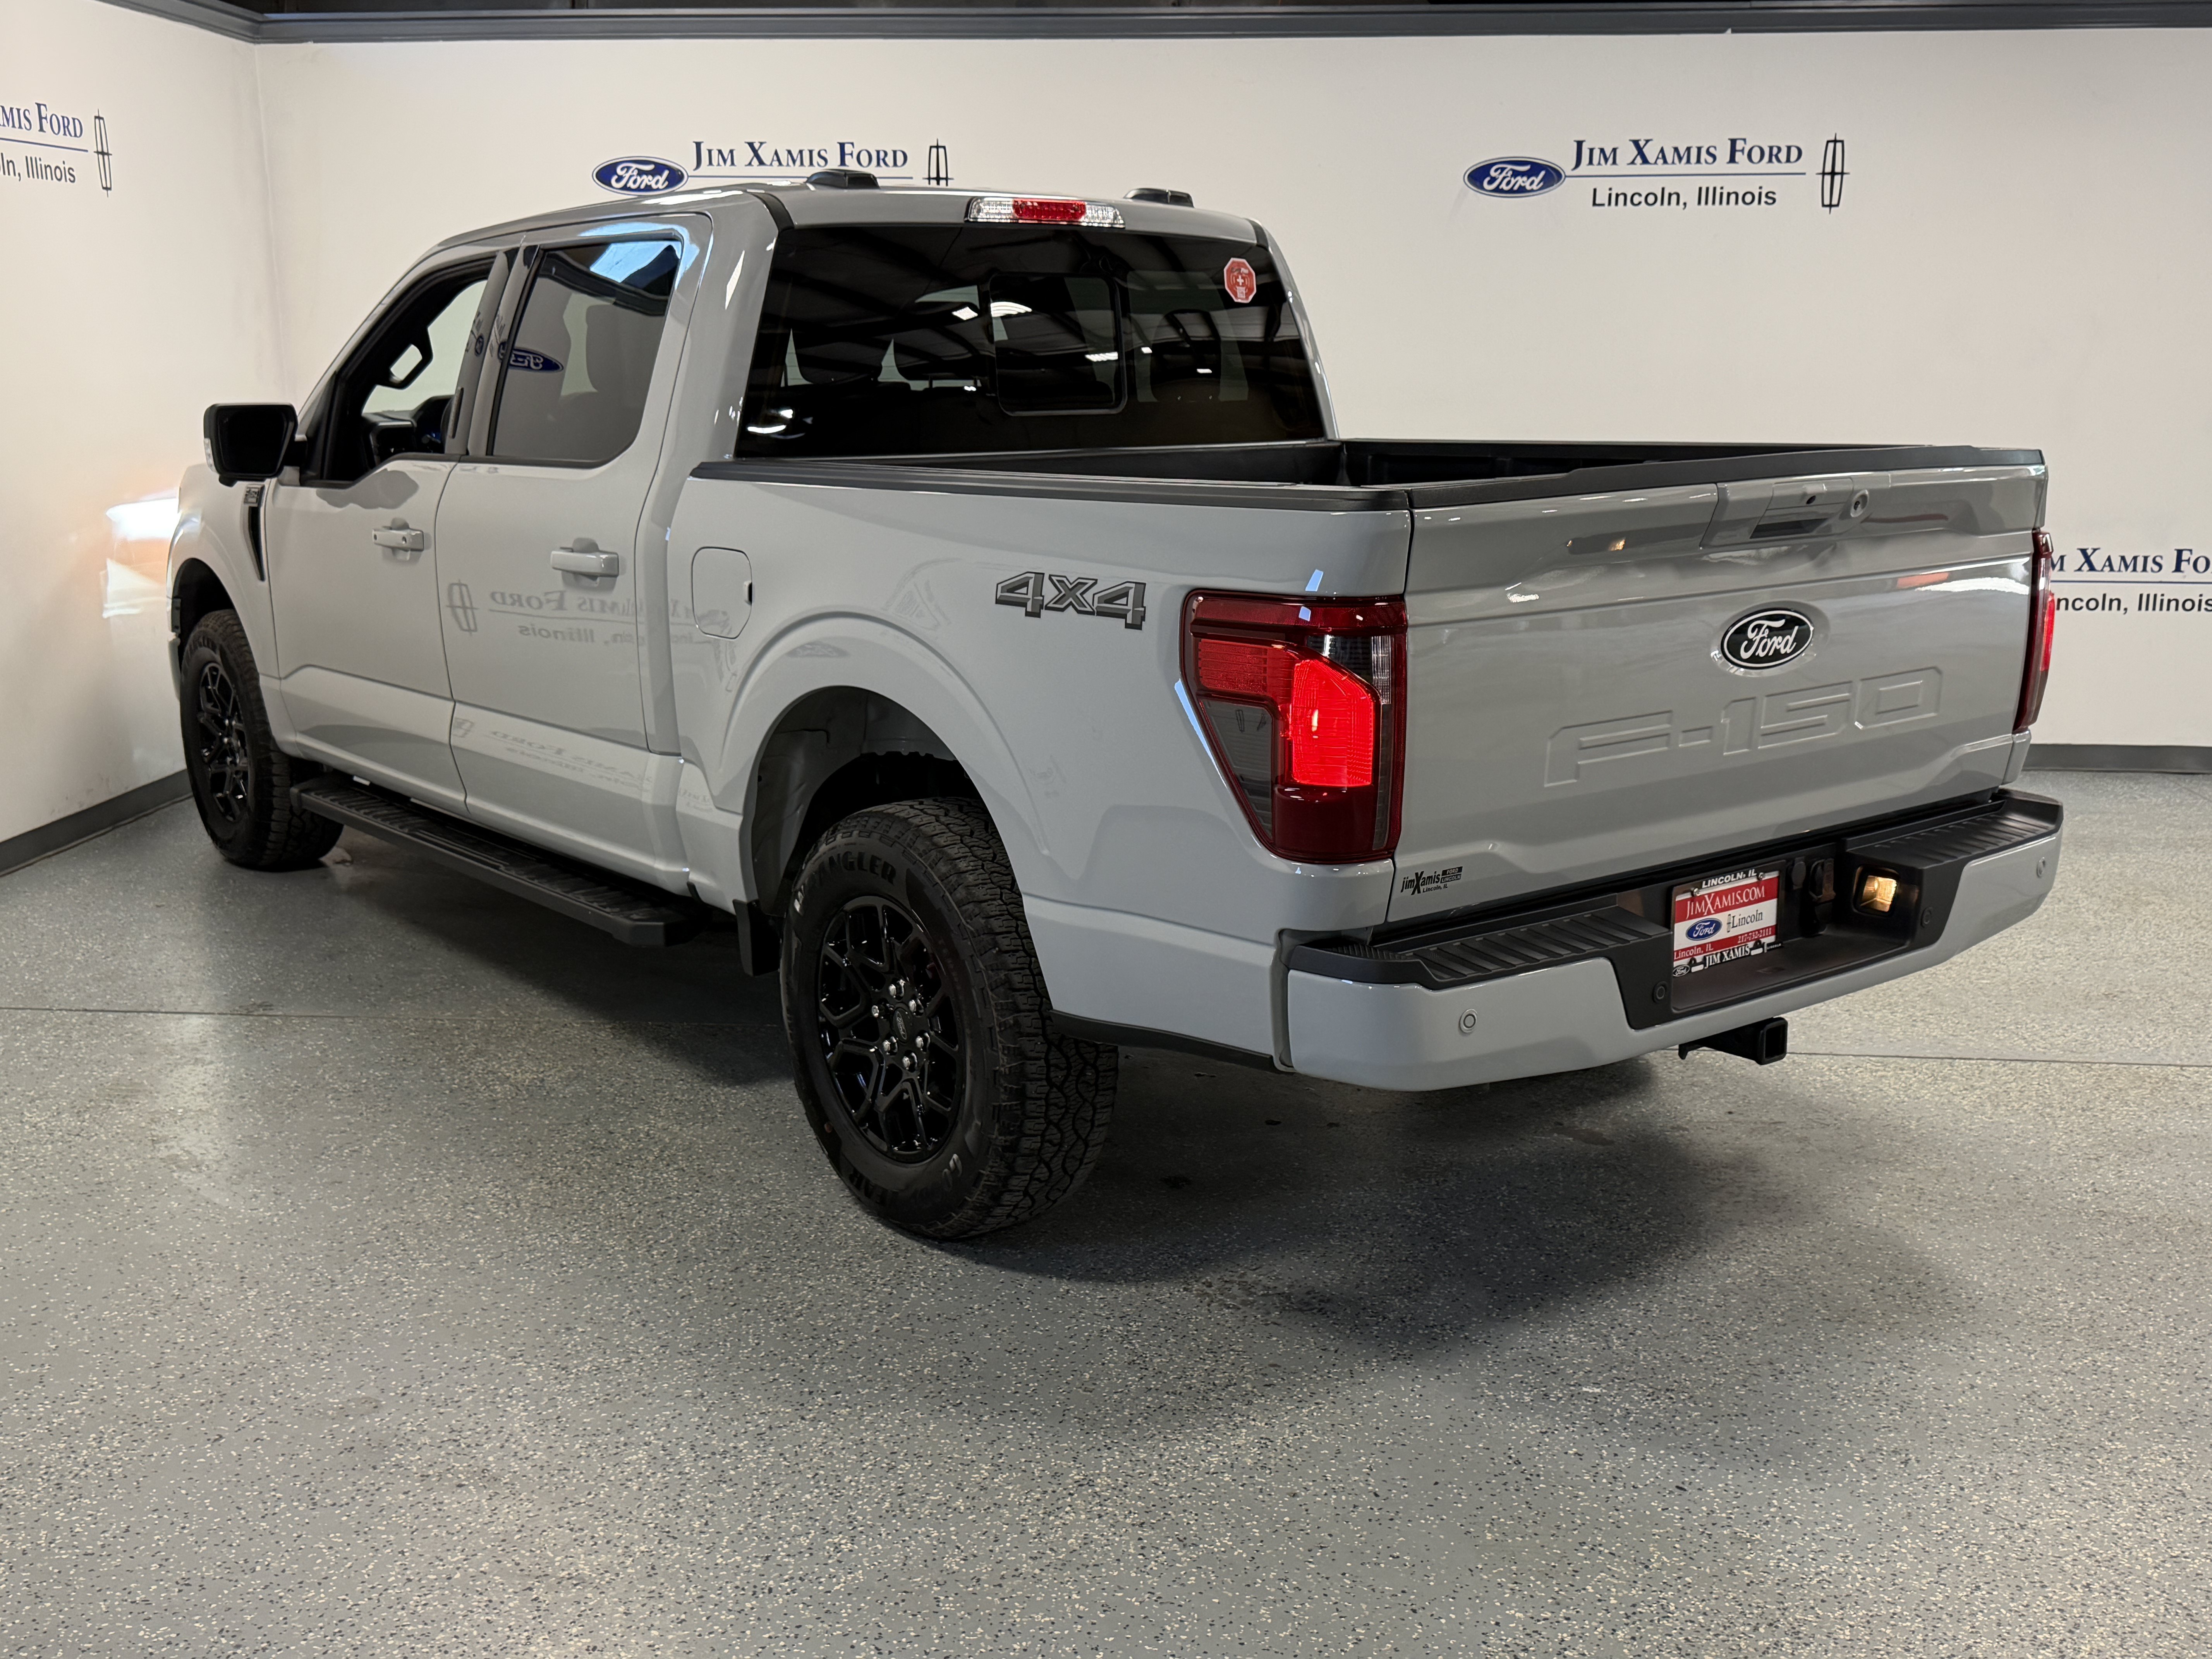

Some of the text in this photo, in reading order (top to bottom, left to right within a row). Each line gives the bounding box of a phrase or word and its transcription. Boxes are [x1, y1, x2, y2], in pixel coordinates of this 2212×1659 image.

[0, 102, 83, 138] MIS FORD
[693, 141, 908, 171] JIM XAMIS FORD
[1571, 138, 1803, 171] JIM XAMIS FORD
[25, 155, 76, 183] Illinois
[611, 163, 669, 189] Ford
[1483, 164, 1546, 191] Ford
[1592, 186, 1777, 210] Lincoln, Illinois
[2074, 548, 2163, 572] XAMIS
[2172, 548, 2212, 574] FO
[995, 571, 1146, 630] 4X4
[2056, 593, 2128, 614] ncoln,
[1740, 619, 1799, 659] Ford
[1544, 666, 1942, 787] F-150
[1442, 874, 1461, 883] LINCOLN
[1702, 869, 1757, 888] LINCOLN, IL
[1693, 921, 1716, 937] Ford
[1731, 910, 1763, 929] Lincoln
[1706, 943, 1714, 951] IL
[1738, 927, 1771, 943] 217-732-2111
[1704, 945, 1750, 969] JIM XAMIS
